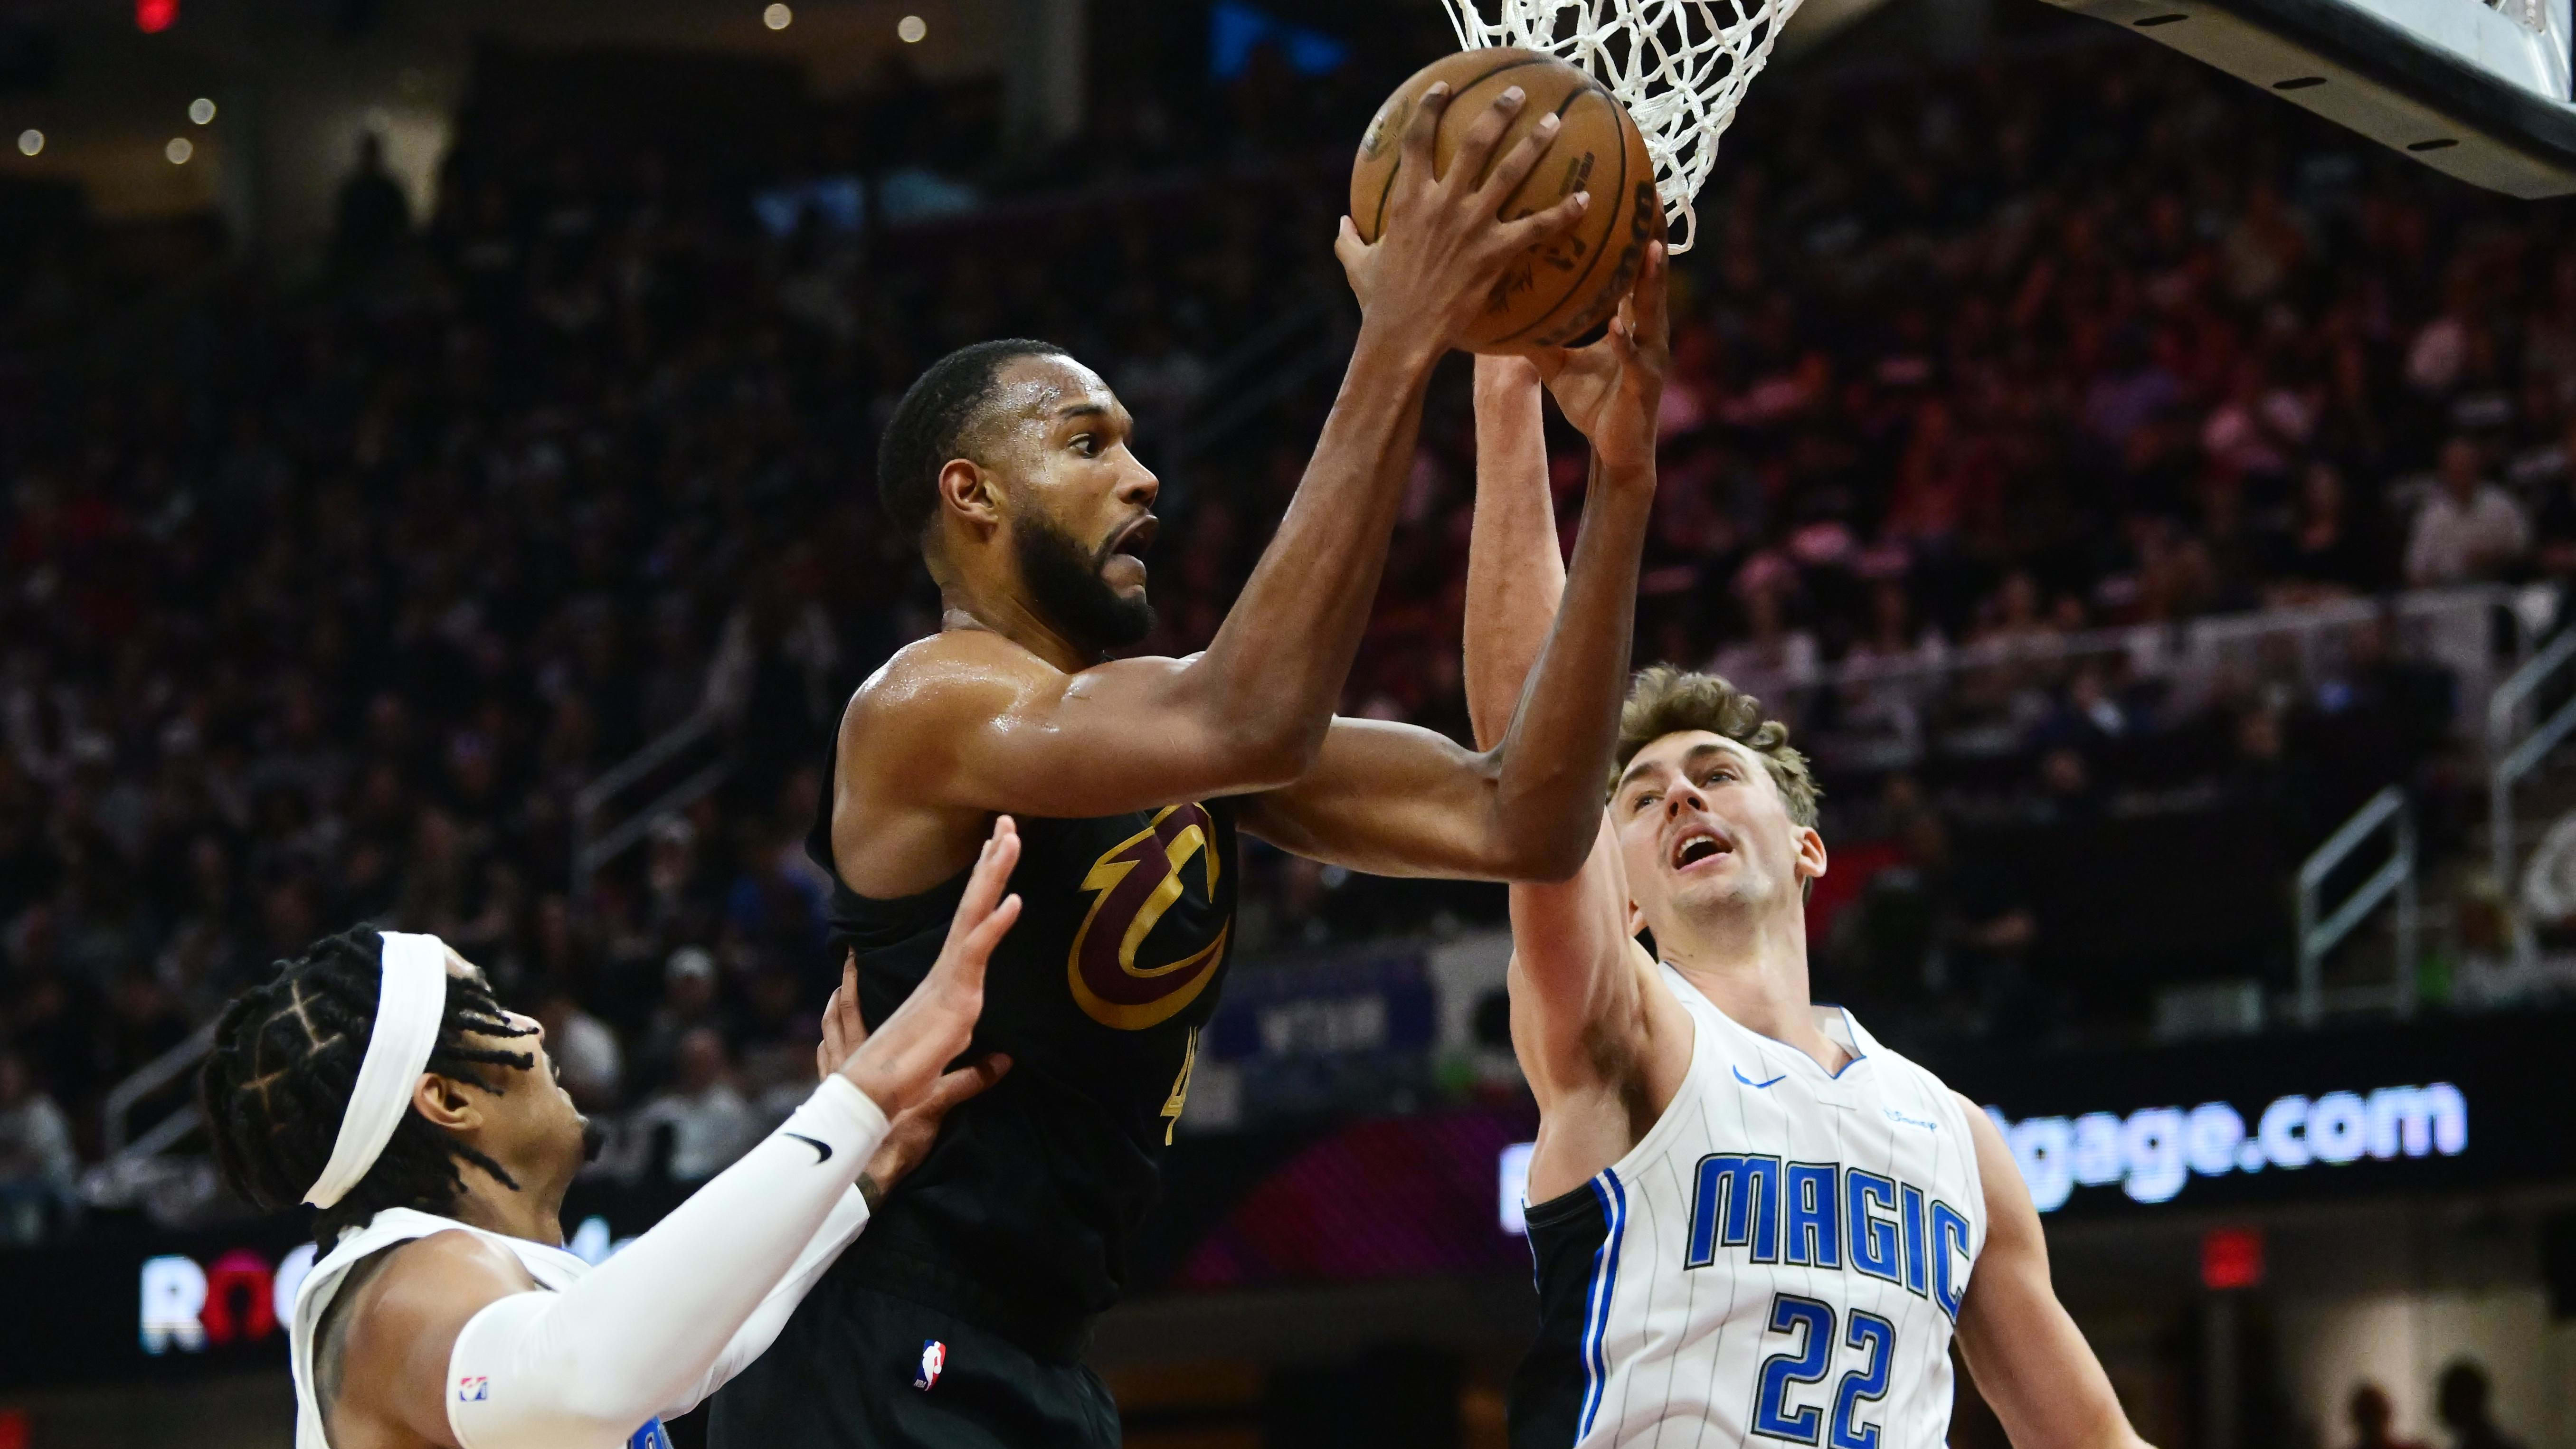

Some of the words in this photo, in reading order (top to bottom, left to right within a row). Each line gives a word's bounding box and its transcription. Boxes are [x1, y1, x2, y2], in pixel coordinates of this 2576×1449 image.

[1983, 1082, 2468, 1212] gage.com
[1684, 1153, 1970, 1326] MAGIC
[1751, 1292, 1896, 1449] 22
